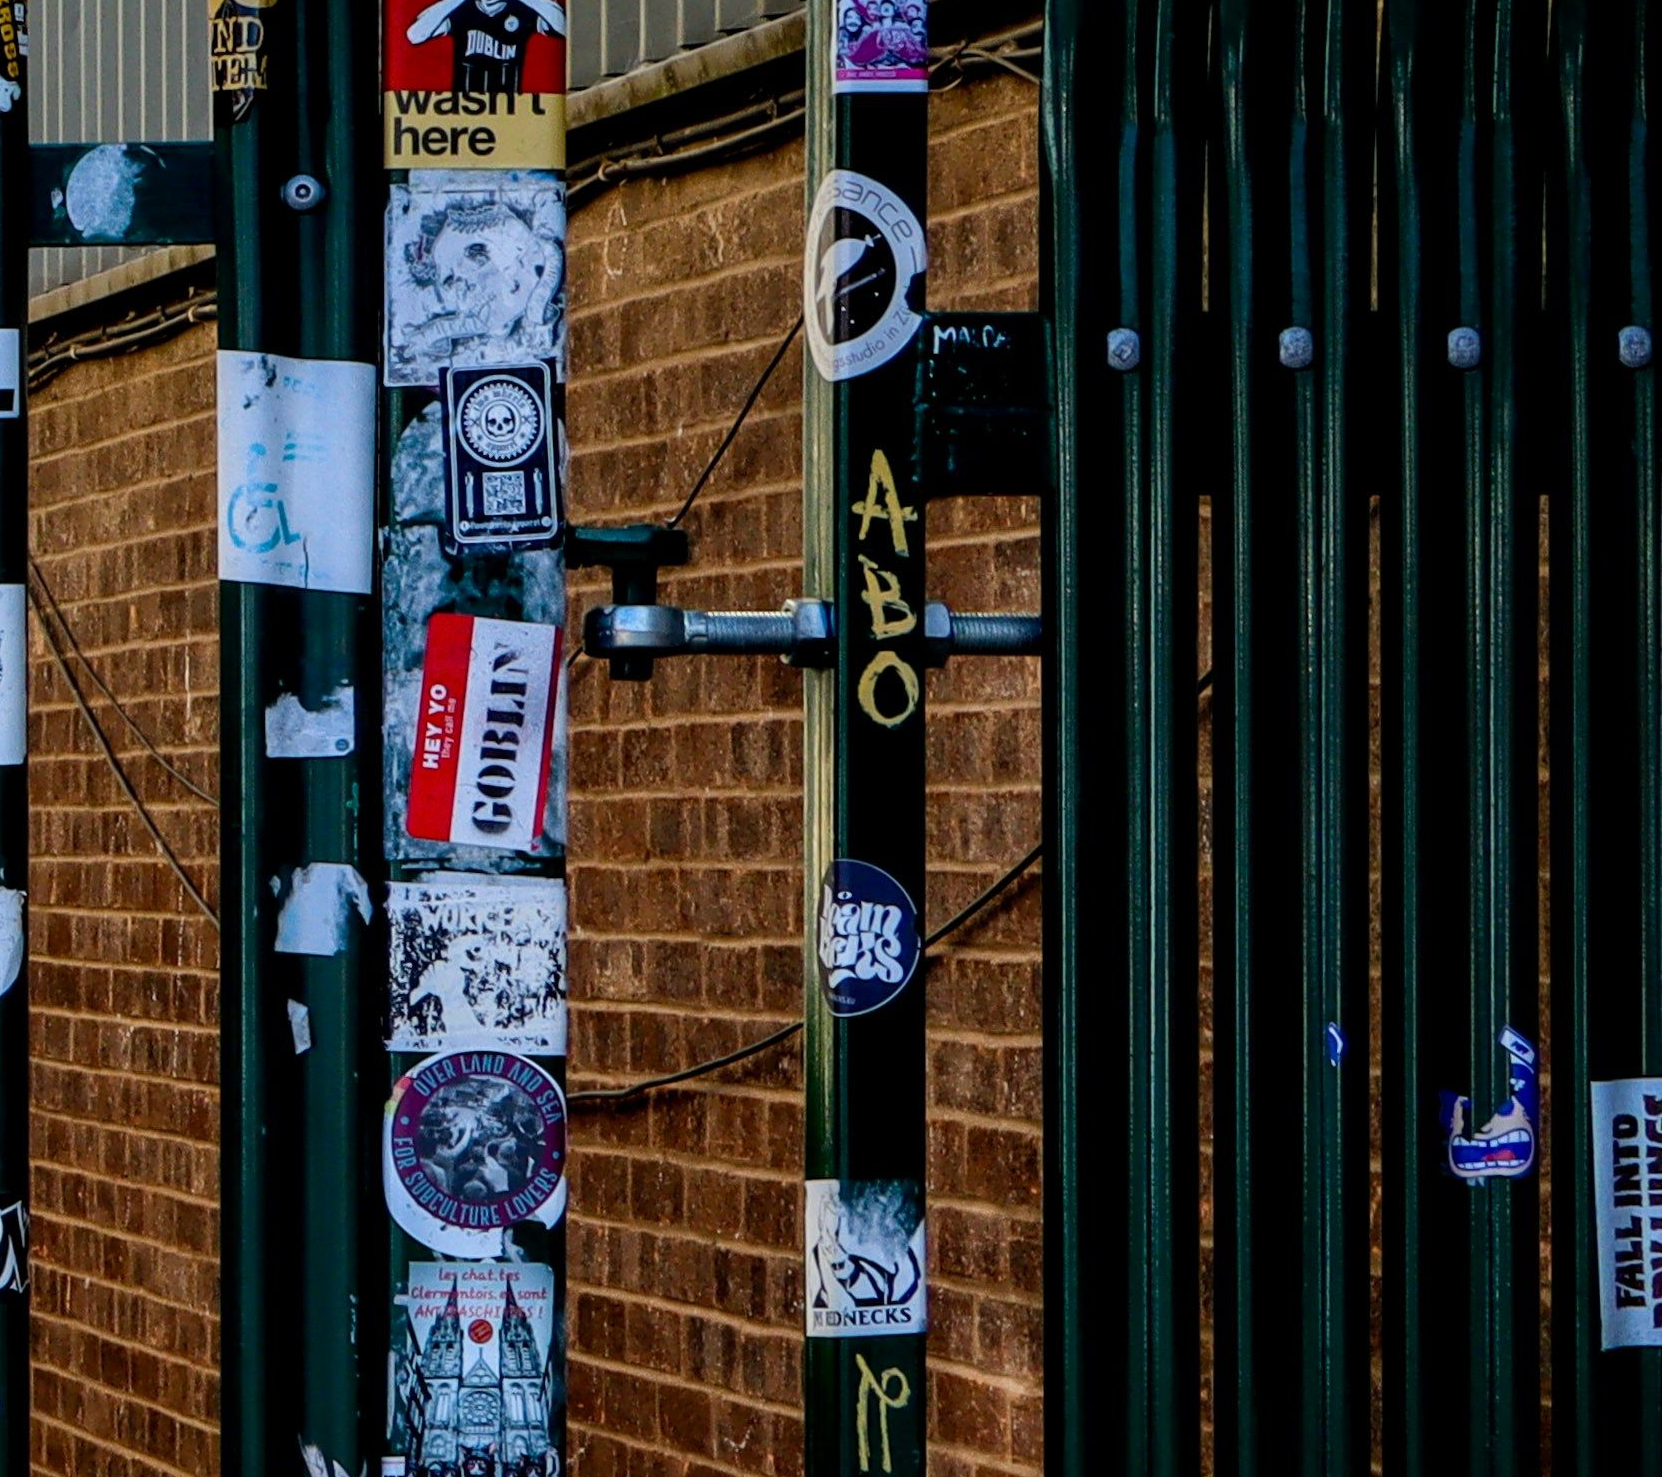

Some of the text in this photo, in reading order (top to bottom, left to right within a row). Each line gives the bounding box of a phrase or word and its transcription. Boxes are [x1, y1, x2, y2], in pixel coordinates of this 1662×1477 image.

[464, 29, 517, 61] DUBLIN
[393, 121, 496, 156] here
[852, 449, 918, 728] ABO
[422, 684, 448, 770] HEY YO
[471, 643, 532, 836] GOBLIN
[413, 1054, 563, 1125] OVER LAND AND SEA
[393, 1137, 558, 1226] FOR SUBCULTURE LOVERS
[1613, 1115, 1647, 1309] FALL INTO
[517, 1287, 548, 1300] sont
